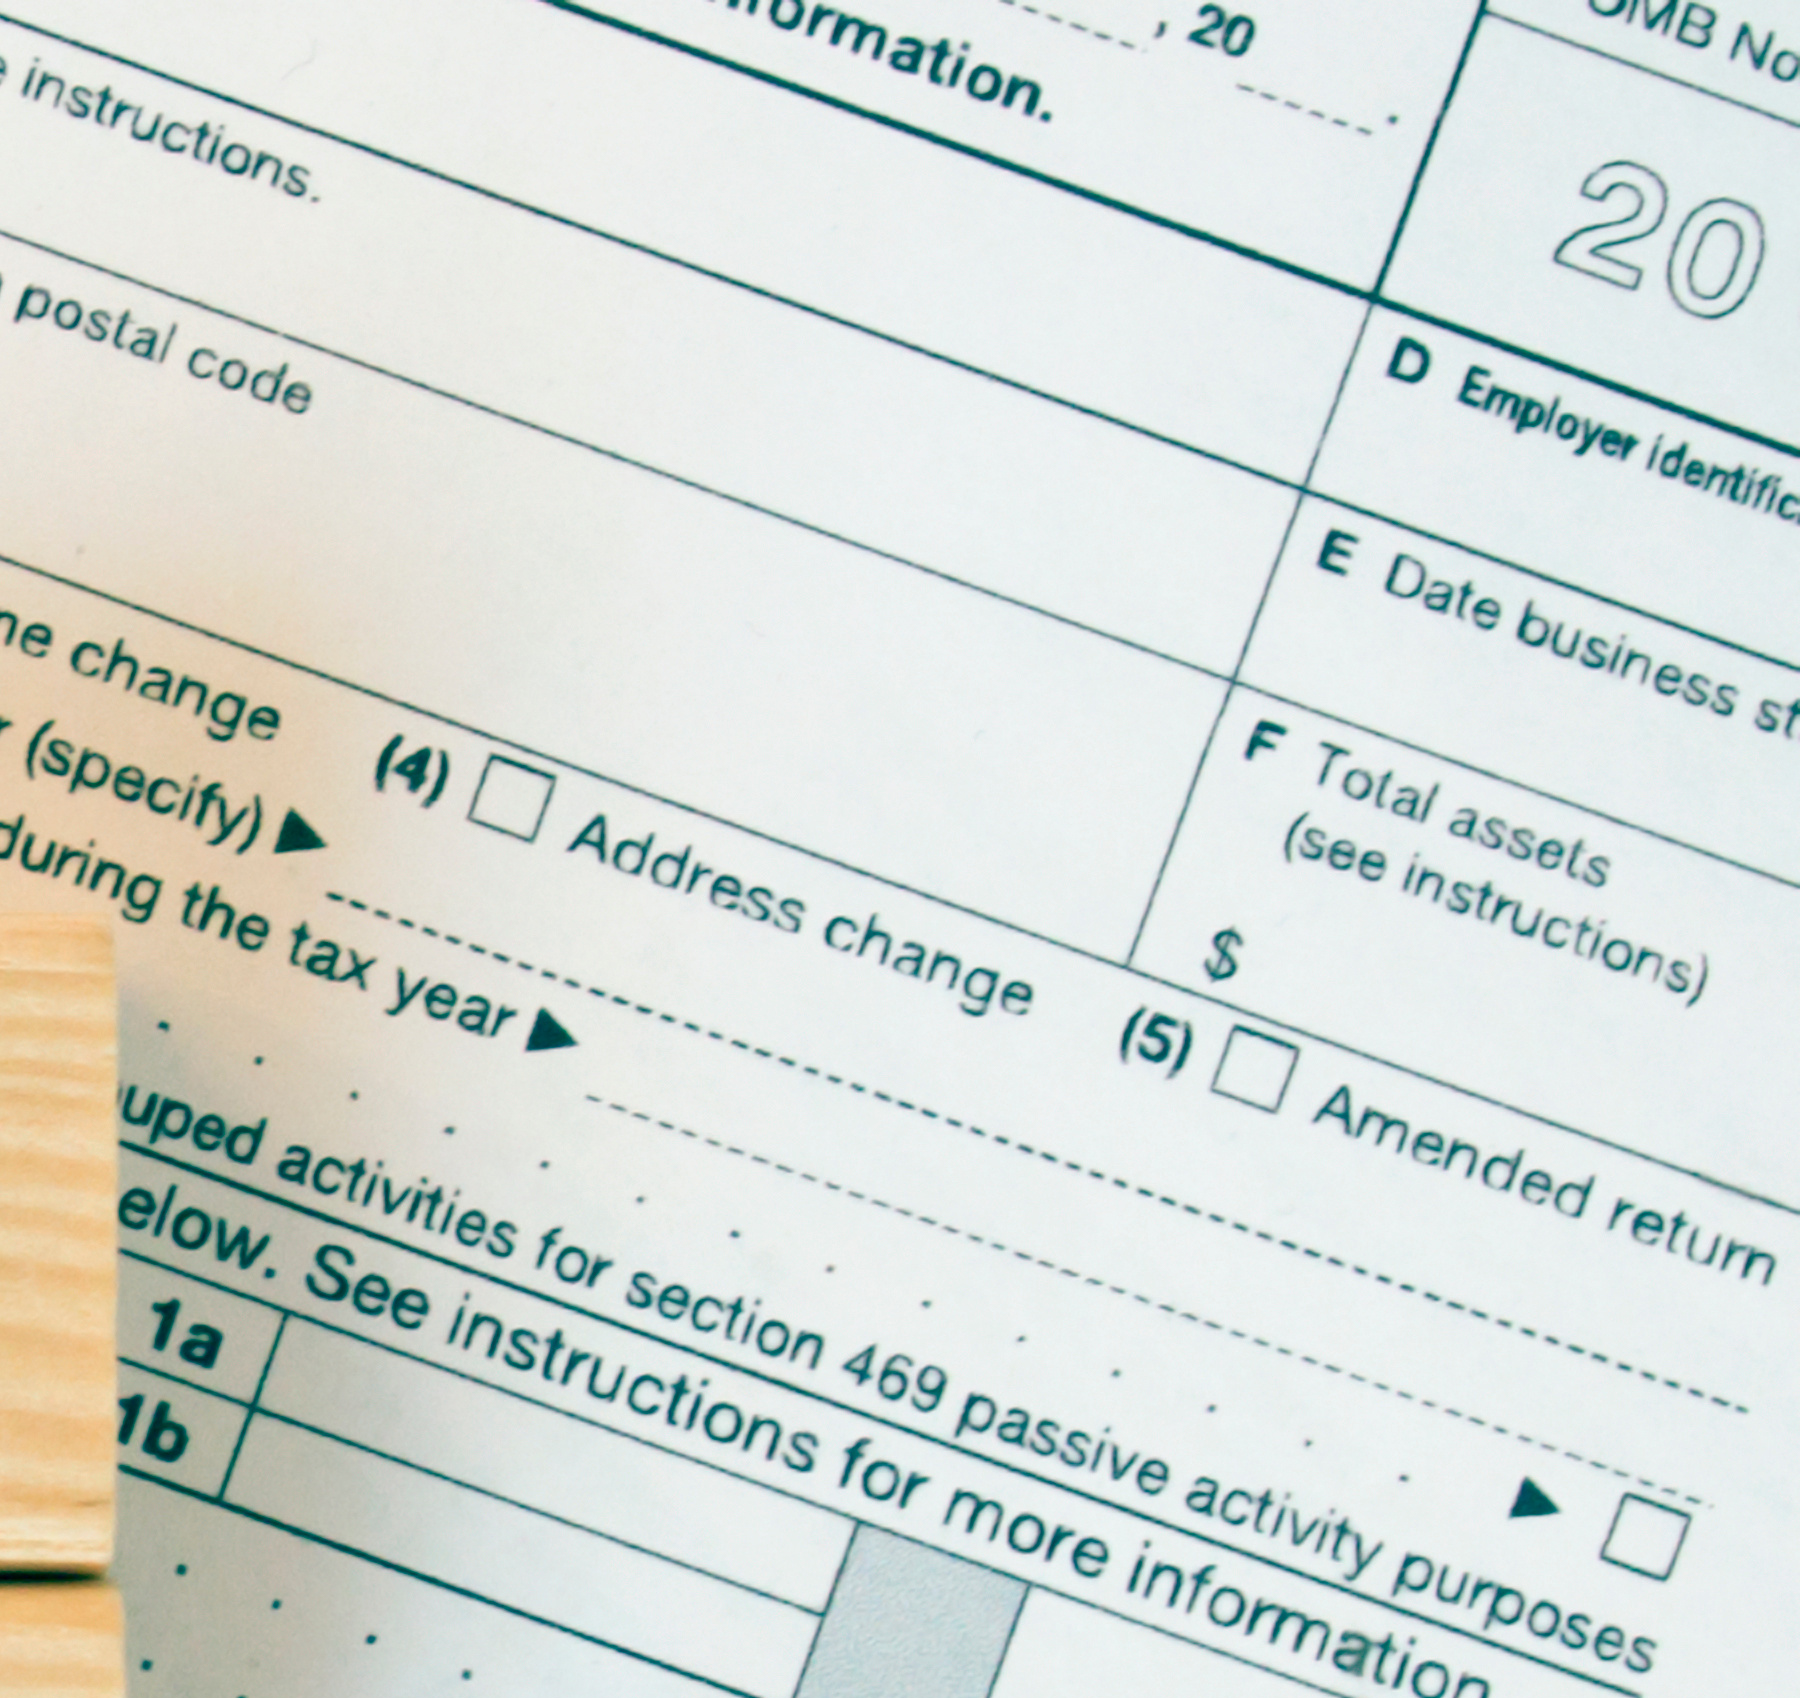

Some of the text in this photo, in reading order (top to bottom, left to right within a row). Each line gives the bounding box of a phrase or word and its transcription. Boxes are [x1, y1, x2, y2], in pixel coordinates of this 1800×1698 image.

[20, 65, 321, 208] instructions.
[1550, 156, 1767, 323] 20
[12, 283, 179, 364] postal
[186, 346, 314, 416] code
[1385, 334, 1642, 459] D Employer
[1315, 527, 1740, 718] E Date business
[23, 718, 265, 857] (specify)
[1243, 718, 1612, 889] F Total assets
[68, 636, 283, 744] change
[373, 732, 452, 810] (4)
[565, 812, 807, 935] Address
[822, 912, 1035, 1019] change
[1118, 1004, 1195, 1080] (5)
[1311, 1083, 1597, 1220] Amended
[1606, 1197, 1778, 1287] return
[179, 880, 272, 954] the
[288, 920, 378, 992] tax
[383, 966, 519, 1039] year
[1202, 926, 1245, 984] $
[1282, 810, 1710, 1009] (see instructions)
[303, 1242, 432, 1332] See
[445, 1304, 821, 1475] instructions
[838, 1436, 932, 1510] for
[942, 1487, 1111, 1580] more
